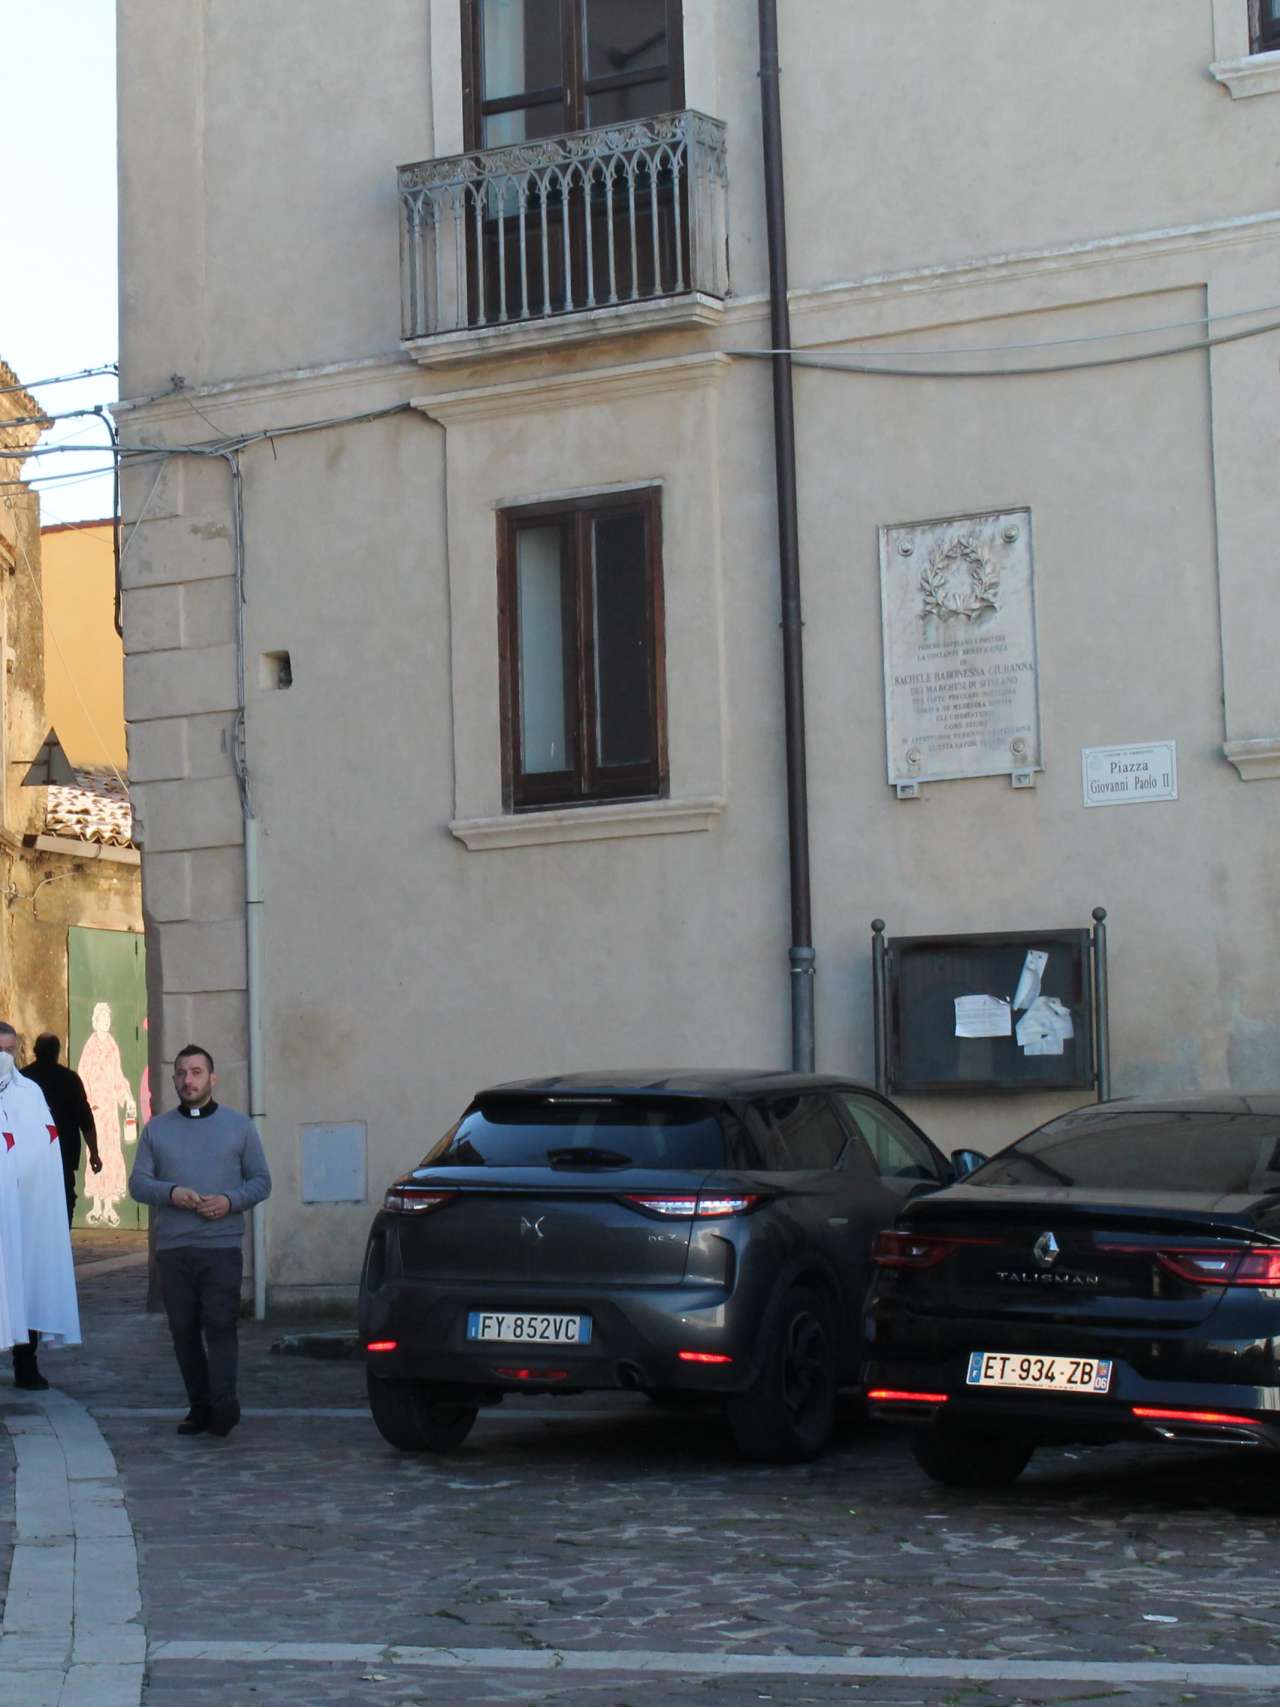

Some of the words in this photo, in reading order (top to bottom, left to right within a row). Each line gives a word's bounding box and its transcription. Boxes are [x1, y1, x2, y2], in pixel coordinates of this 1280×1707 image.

[1110, 761, 1149, 774] Piazza
[1090, 777, 1128, 794] Giovanni
[1135, 775, 1157, 790] Paolo
[1162, 773, 1169, 788] II
[996, 1272, 1099, 1285] TALISMAN
[482, 1316, 505, 1338] FY
[513, 1317, 577, 1340] 852VC
[984, 1356, 1093, 1385] ET-934-ZB
